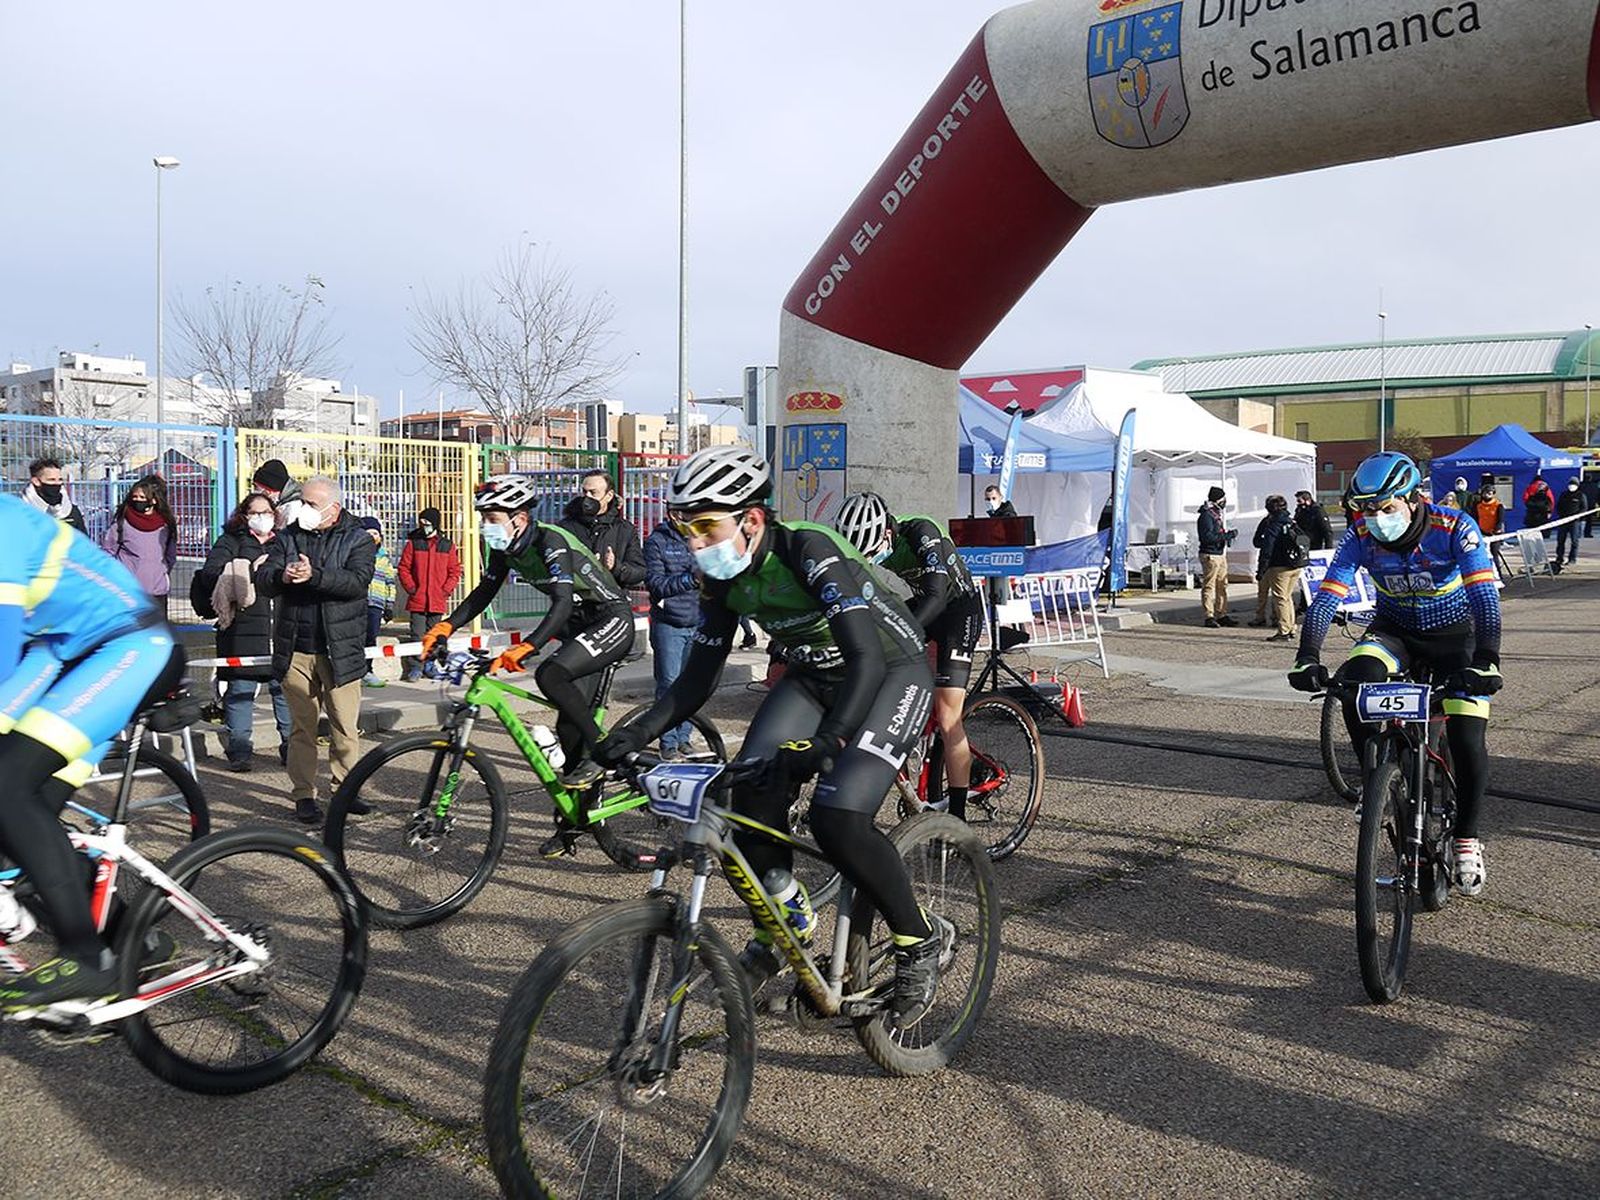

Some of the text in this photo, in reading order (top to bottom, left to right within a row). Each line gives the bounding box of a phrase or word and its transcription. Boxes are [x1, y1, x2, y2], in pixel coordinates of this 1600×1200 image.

[1202, 1, 1482, 91] de Salamanca
[804, 75, 989, 316] CON EL DEPORTE
[1378, 695, 1405, 711] 45
[857, 729, 907, 770] E
